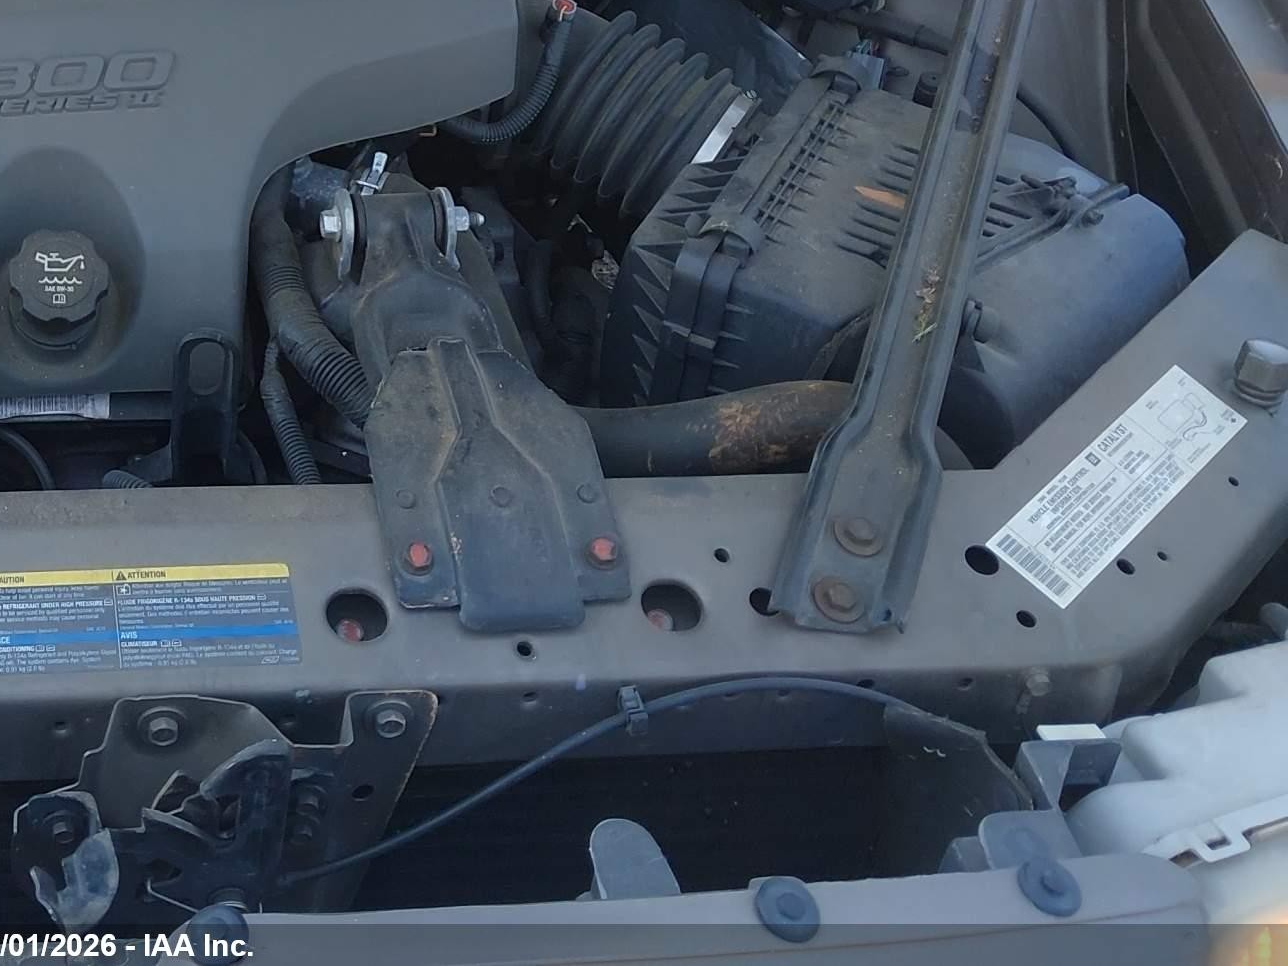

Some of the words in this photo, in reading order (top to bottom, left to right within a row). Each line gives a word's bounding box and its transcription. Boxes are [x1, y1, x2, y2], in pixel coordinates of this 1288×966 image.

[1096, 423, 1128, 452] CATALYST
[1027, 503, 1049, 524] VEHICLE
[1045, 483, 1070, 506] EMISSION
[1065, 466, 1088, 487] CONTROL
[127, 571, 166, 579] ATTENTION
